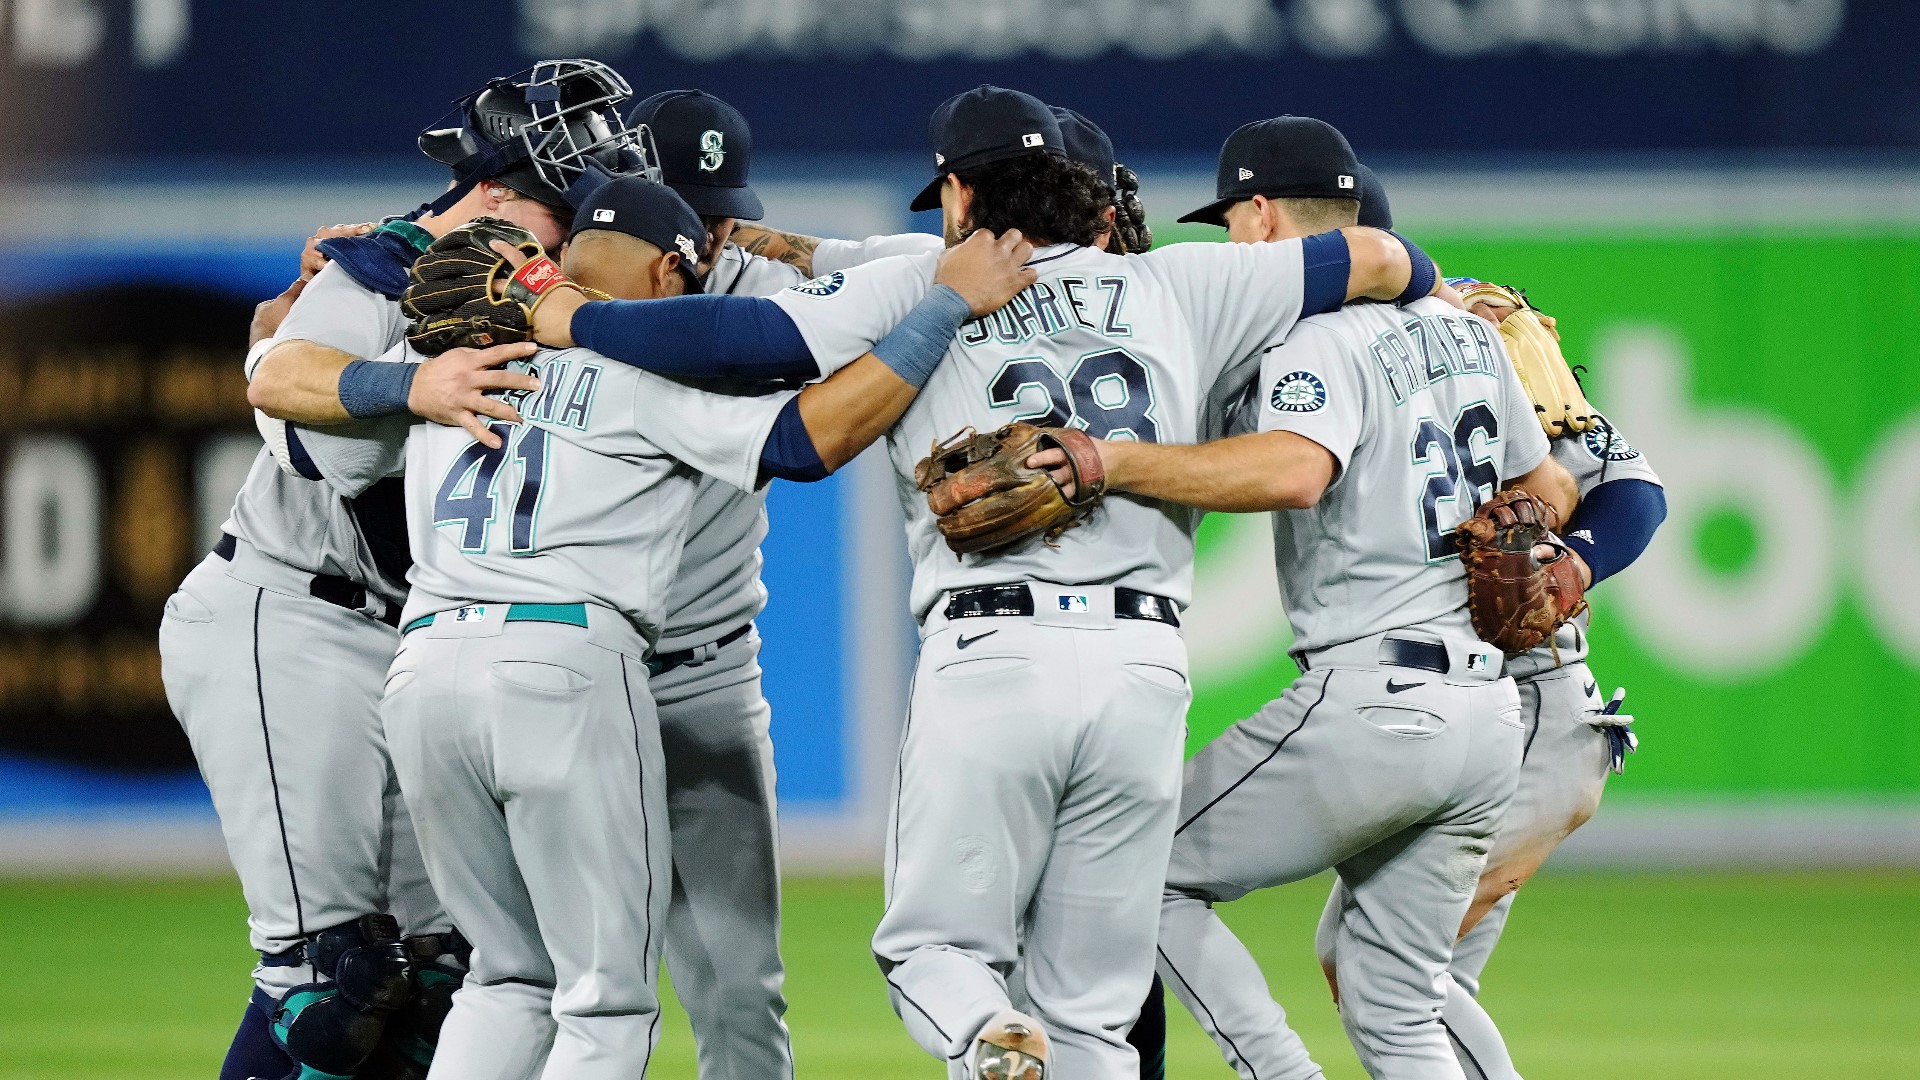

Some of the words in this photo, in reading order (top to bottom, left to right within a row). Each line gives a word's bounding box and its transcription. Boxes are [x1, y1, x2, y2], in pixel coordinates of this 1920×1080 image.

[698, 130, 726, 171] S
[433, 419, 550, 555] 41
[1411, 400, 1501, 565] 26
